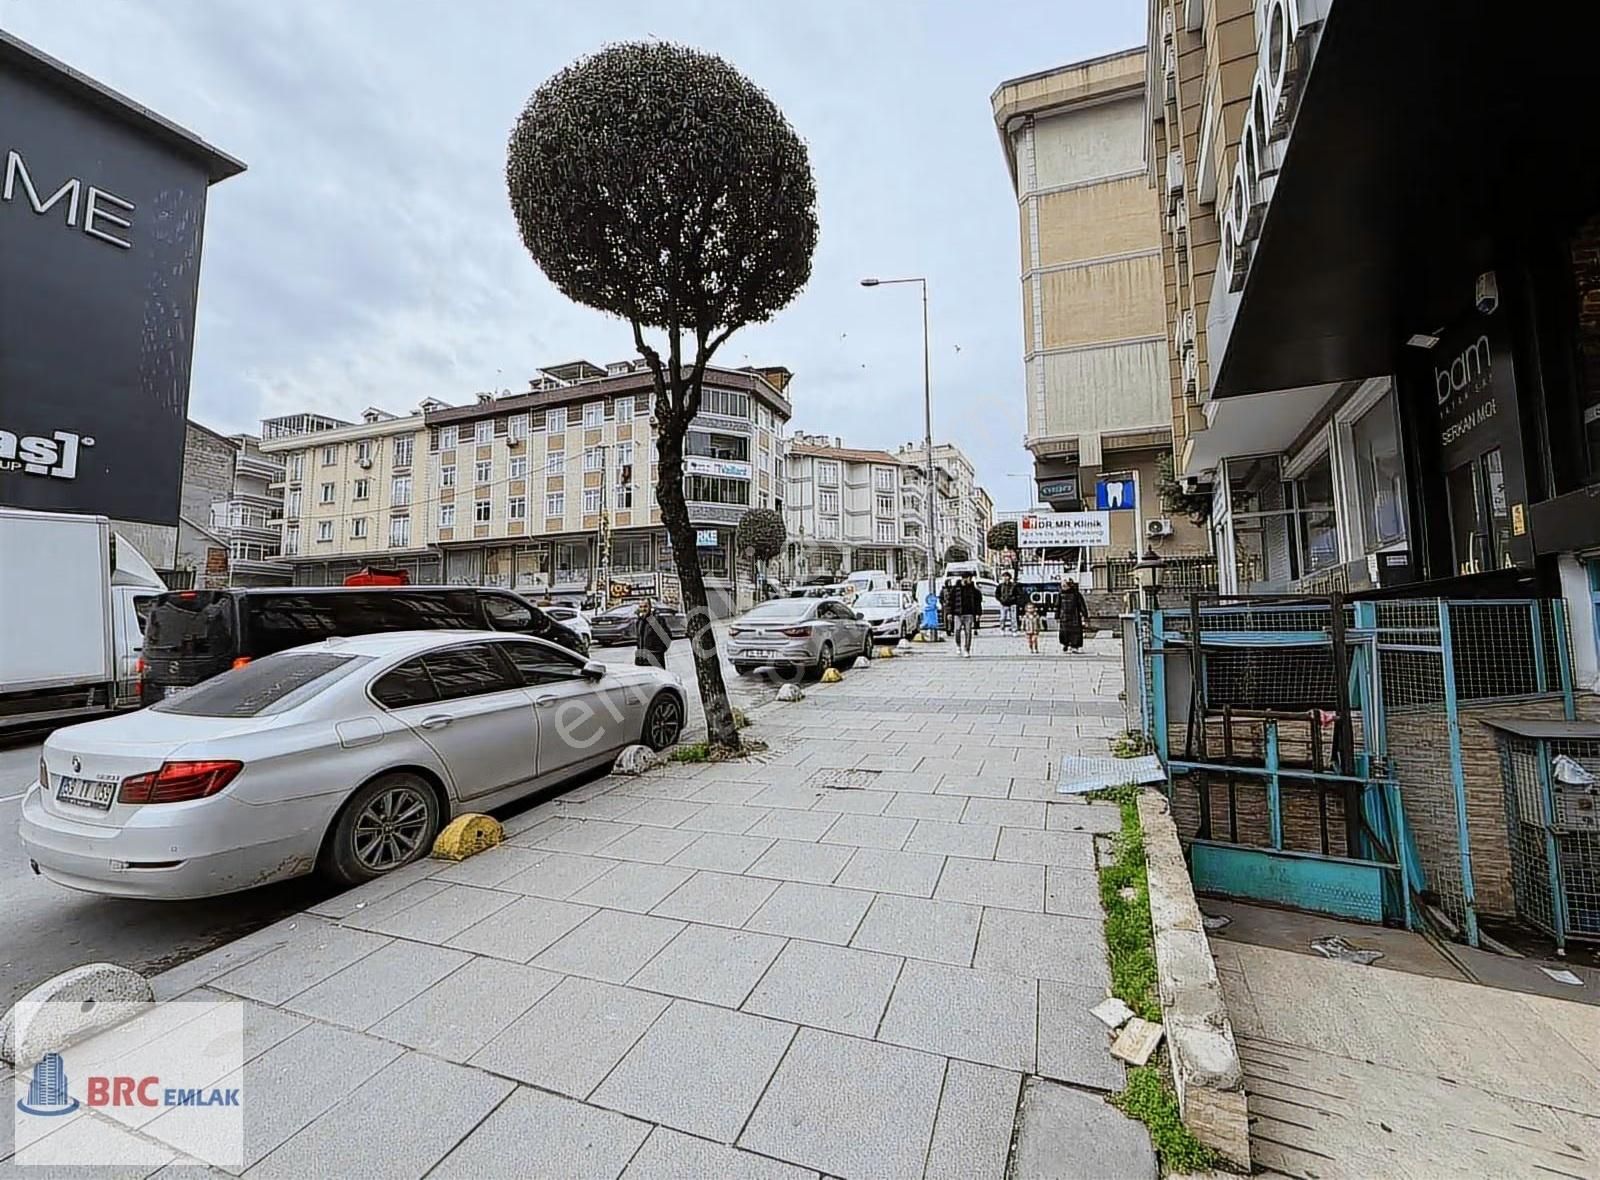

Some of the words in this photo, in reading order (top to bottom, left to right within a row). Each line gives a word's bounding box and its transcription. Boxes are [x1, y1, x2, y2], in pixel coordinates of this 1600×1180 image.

[3, 149, 136, 249] ME
[1434, 335, 1492, 405] bam
[696, 530, 717, 542] RKE
[1073, 519, 1102, 528] Klinik
